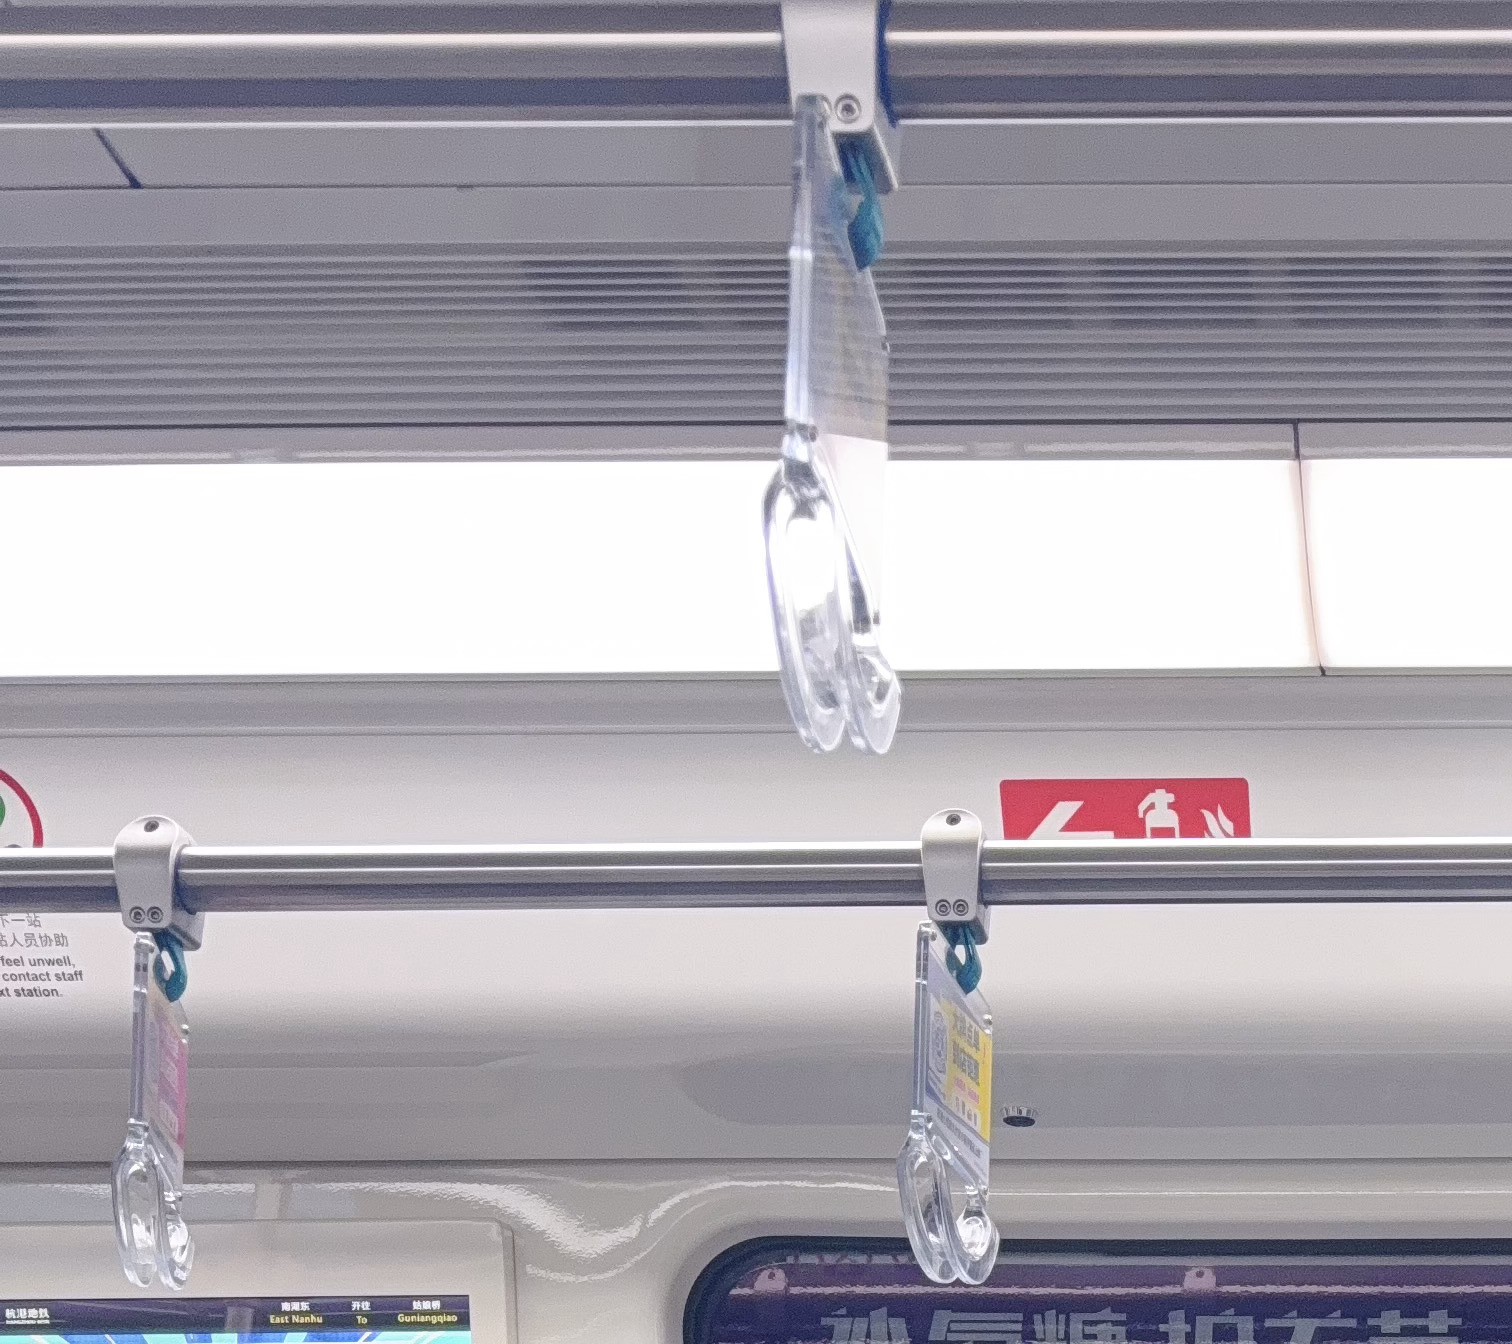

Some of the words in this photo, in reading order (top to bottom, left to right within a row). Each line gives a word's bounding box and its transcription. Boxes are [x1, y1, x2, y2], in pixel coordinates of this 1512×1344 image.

[28, 955, 76, 969] unwell,
[2, 971, 52, 982] contact
[54, 970, 84, 982] staff
[14, 986, 64, 998] station.
[269, 1315, 289, 1324] East
[291, 1314, 323, 1324] Nanhu
[356, 1315, 368, 1325] To
